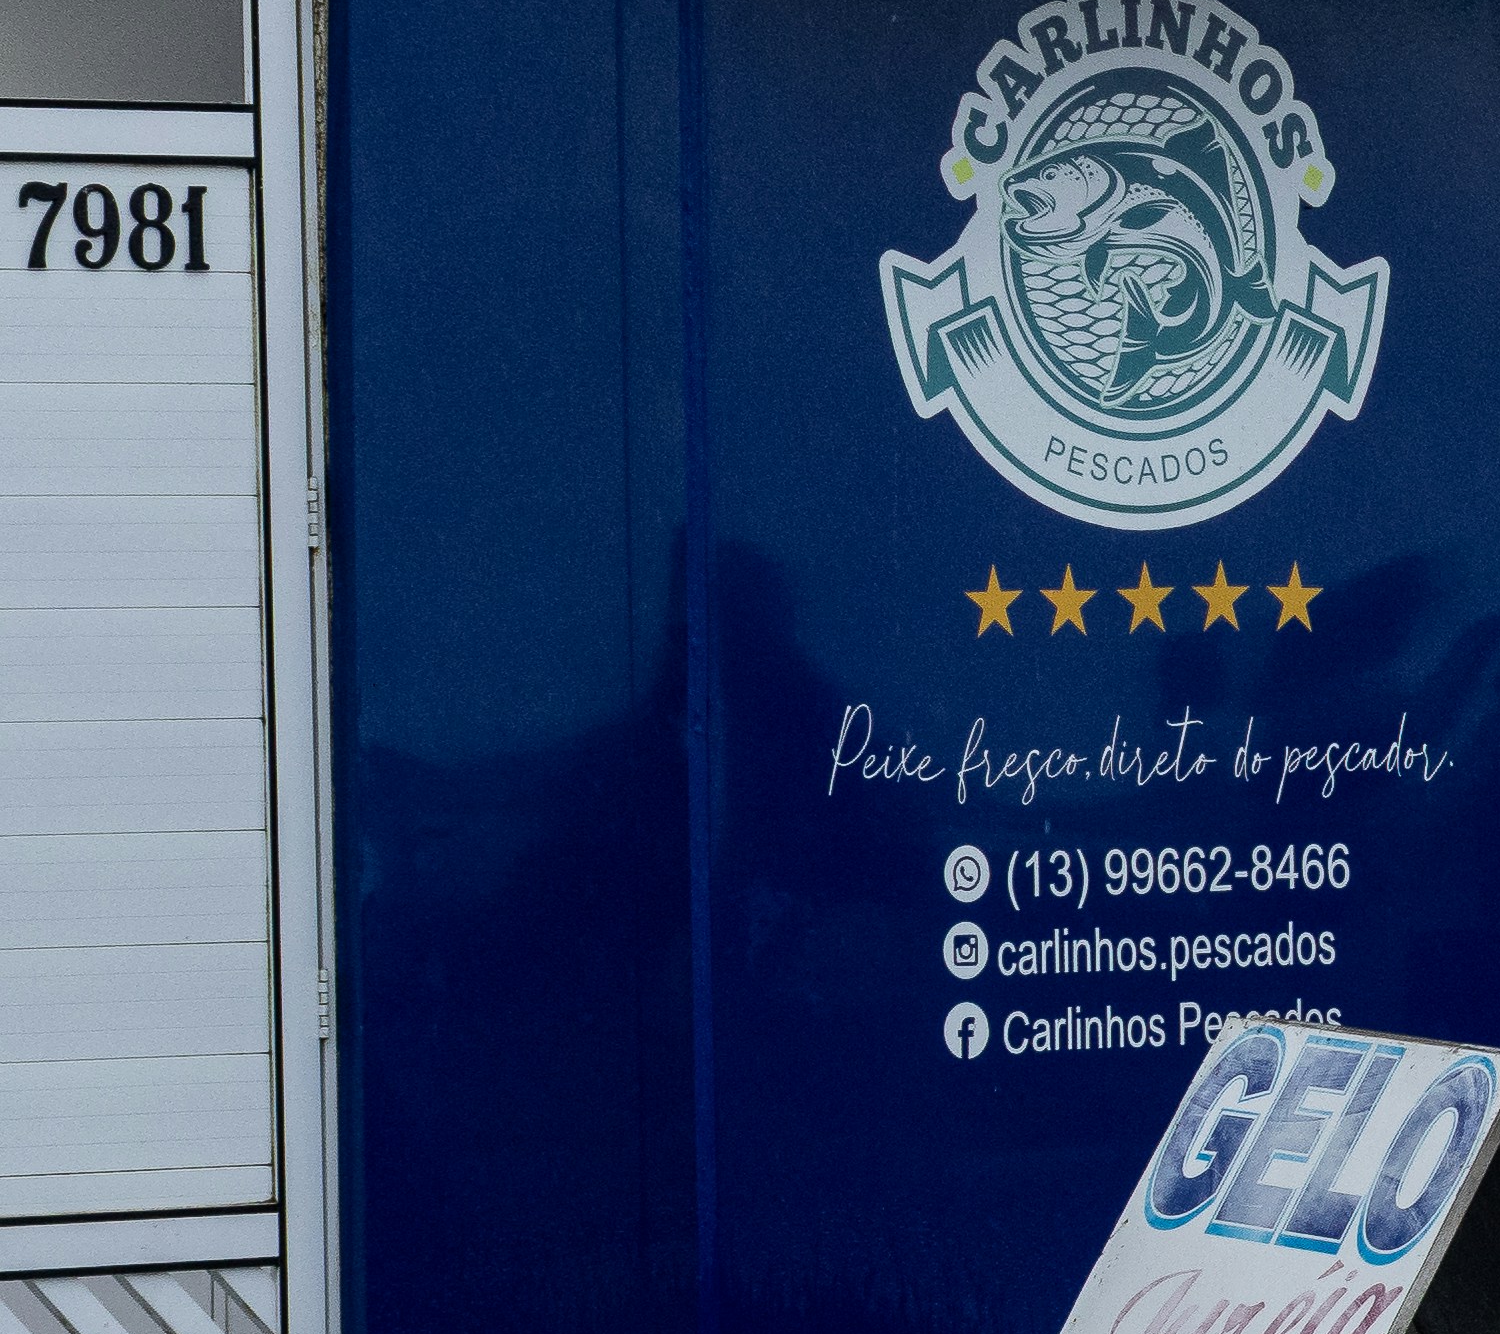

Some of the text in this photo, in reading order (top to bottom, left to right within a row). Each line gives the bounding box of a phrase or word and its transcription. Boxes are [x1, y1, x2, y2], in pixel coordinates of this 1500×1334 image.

[18, 181, 211, 270] 7981
[1044, 436, 1230, 485] PESCADOS
[829, 703, 945, 796] Peixe
[1099, 705, 1217, 786] direto
[1233, 716, 1274, 782] do
[1276, 712, 1455, 805] pescador.
[1007, 843, 1351, 909] (13) 99662-8466
[999, 922, 1336, 981] carlinhos.pescados
[1003, 1006, 1167, 1055] Carlinhos
[1144, 1025, 1496, 1266] GELO
